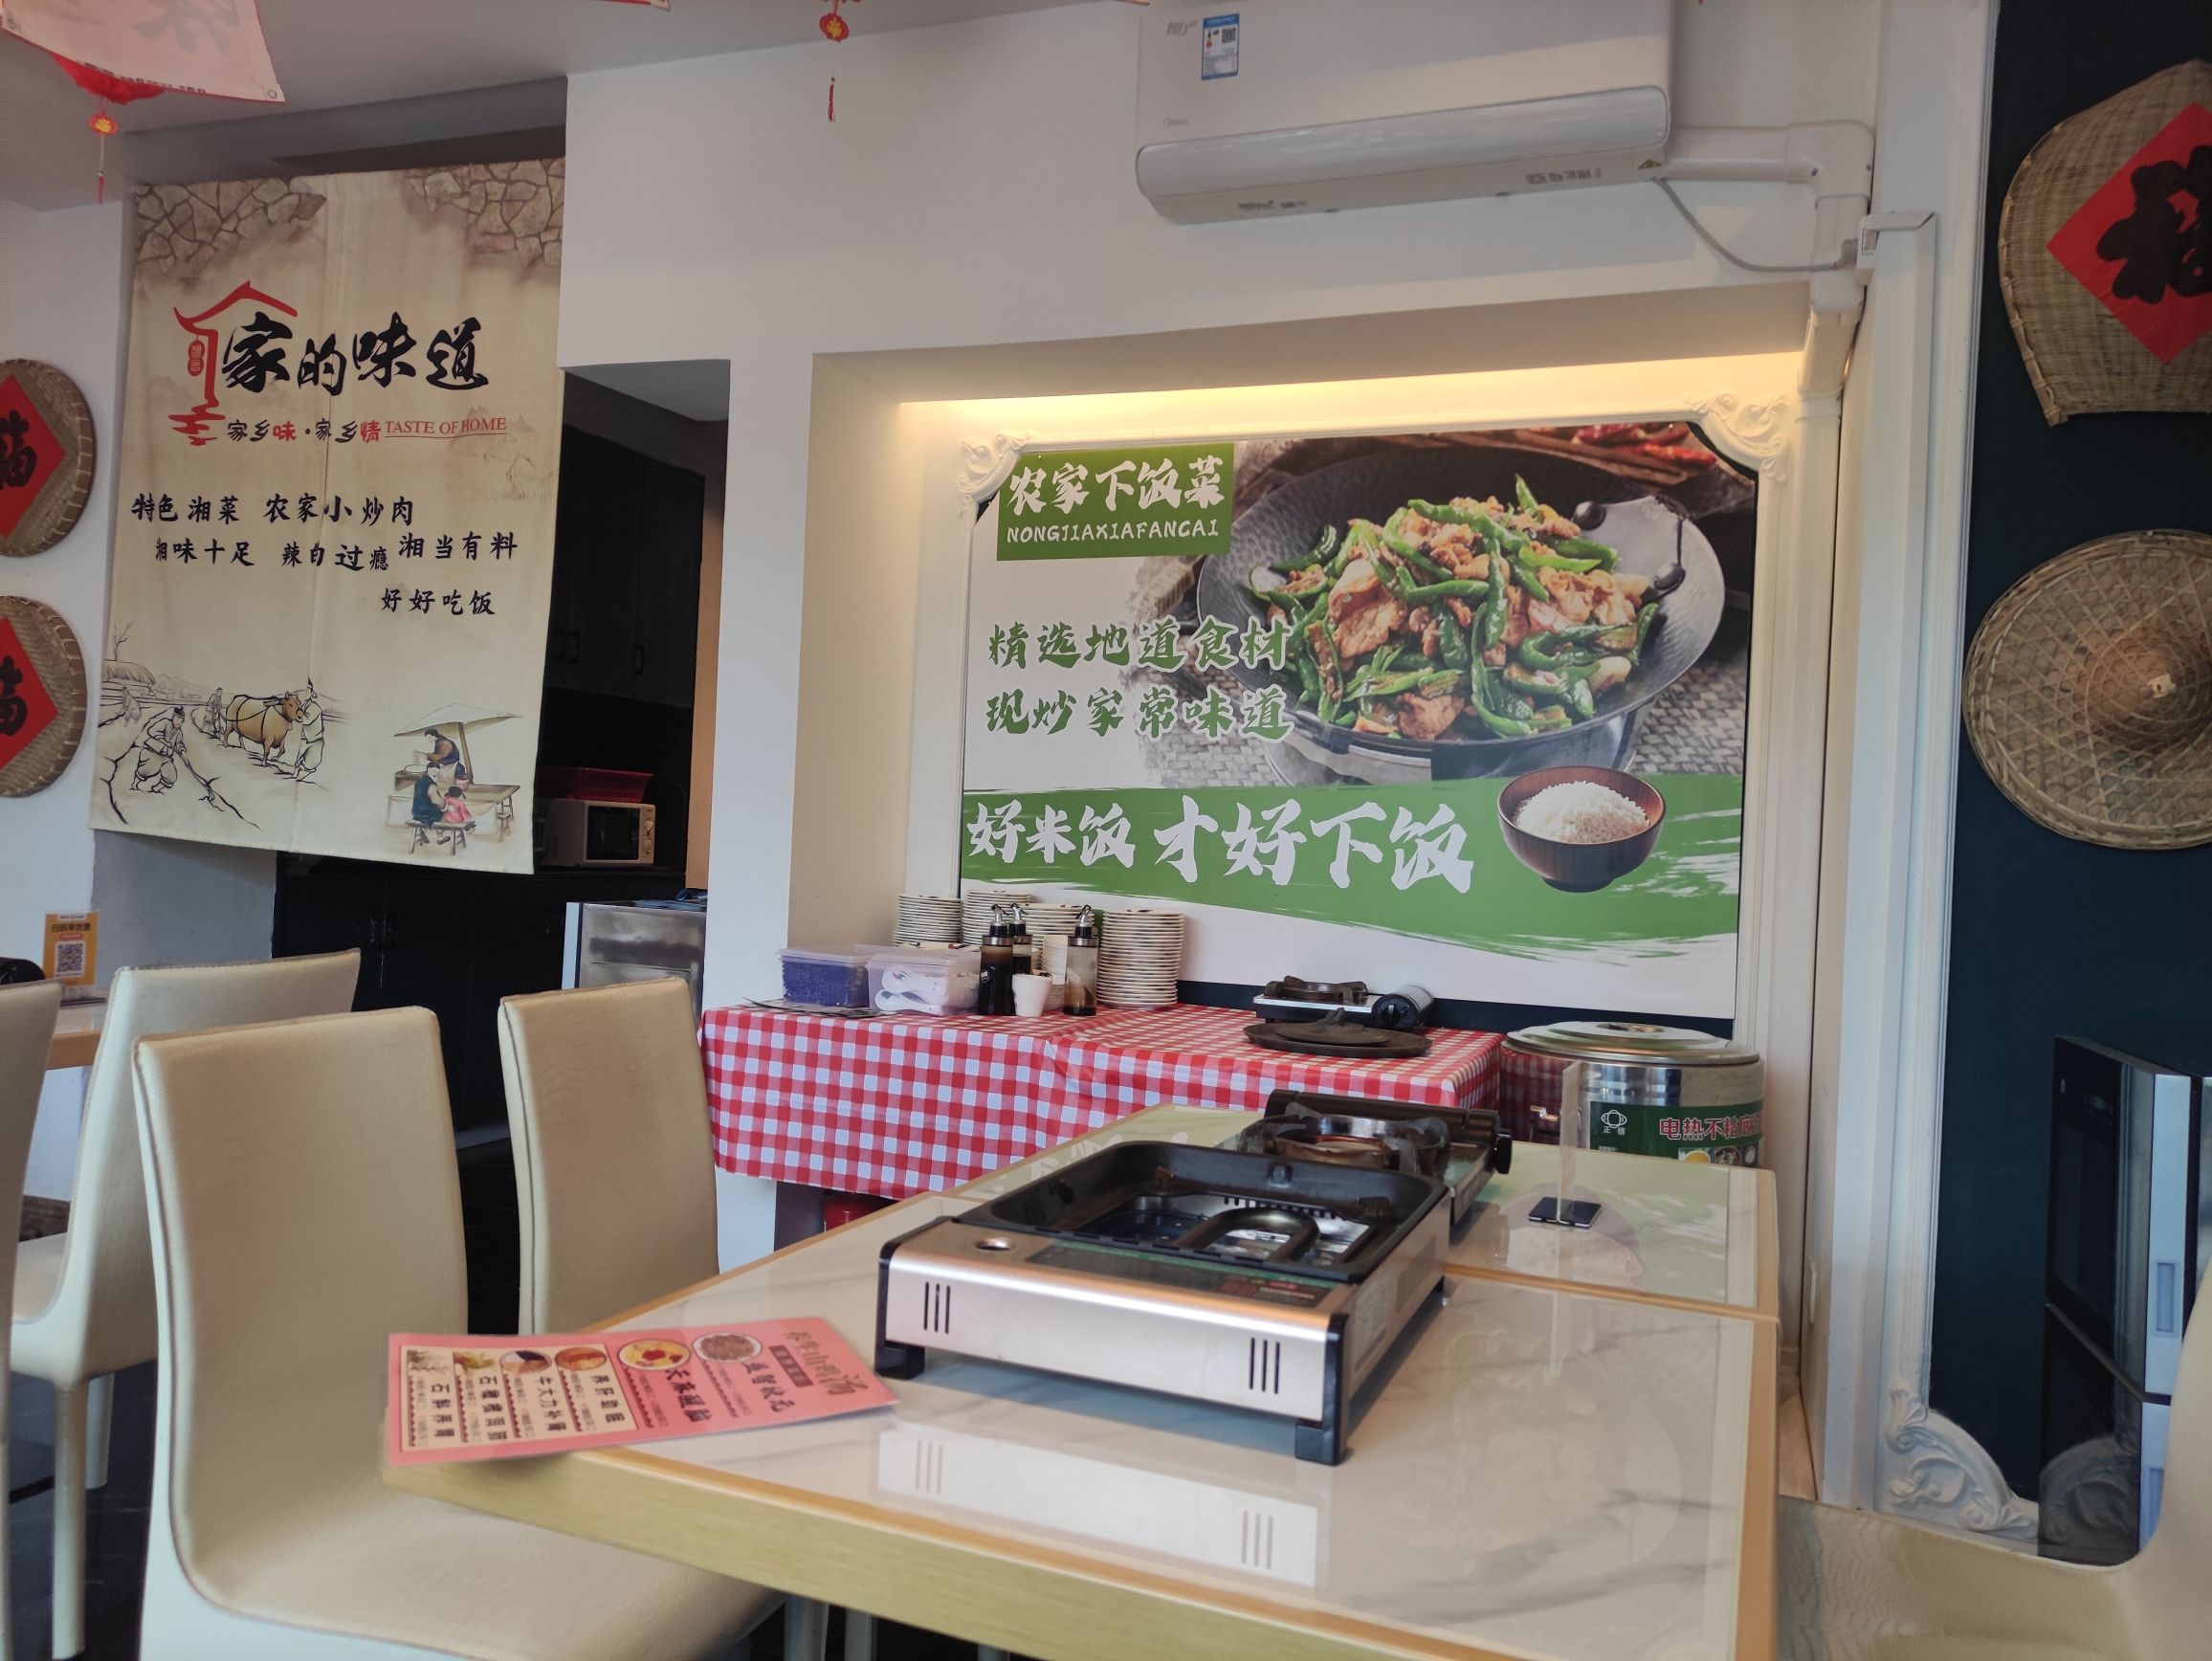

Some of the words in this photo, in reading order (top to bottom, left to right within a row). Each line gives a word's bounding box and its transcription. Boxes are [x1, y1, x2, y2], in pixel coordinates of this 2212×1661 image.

[222, 311, 489, 395] 家的味道
[385, 420, 434, 434] TASTE
[439, 421, 458, 435] OF
[460, 417, 506, 432] HOME
[1006, 454, 1225, 517] 农家下饭菜
[131, 493, 239, 525] 特色湘菜
[263, 492, 413, 527] 农家小炒肉
[1006, 519, 1219, 543] NONGJIAXIAFANCAI
[156, 538, 255, 567] 湘味十足
[399, 531, 518, 561] 湘当有料
[382, 588, 496, 615] 好好吃饭
[987, 617, 1291, 670] 精选地道食材
[986, 687, 1294, 741] 现炒家常味道
[965, 799, 1137, 869] 好米饭
[1153, 794, 1474, 894] 才好下饭
